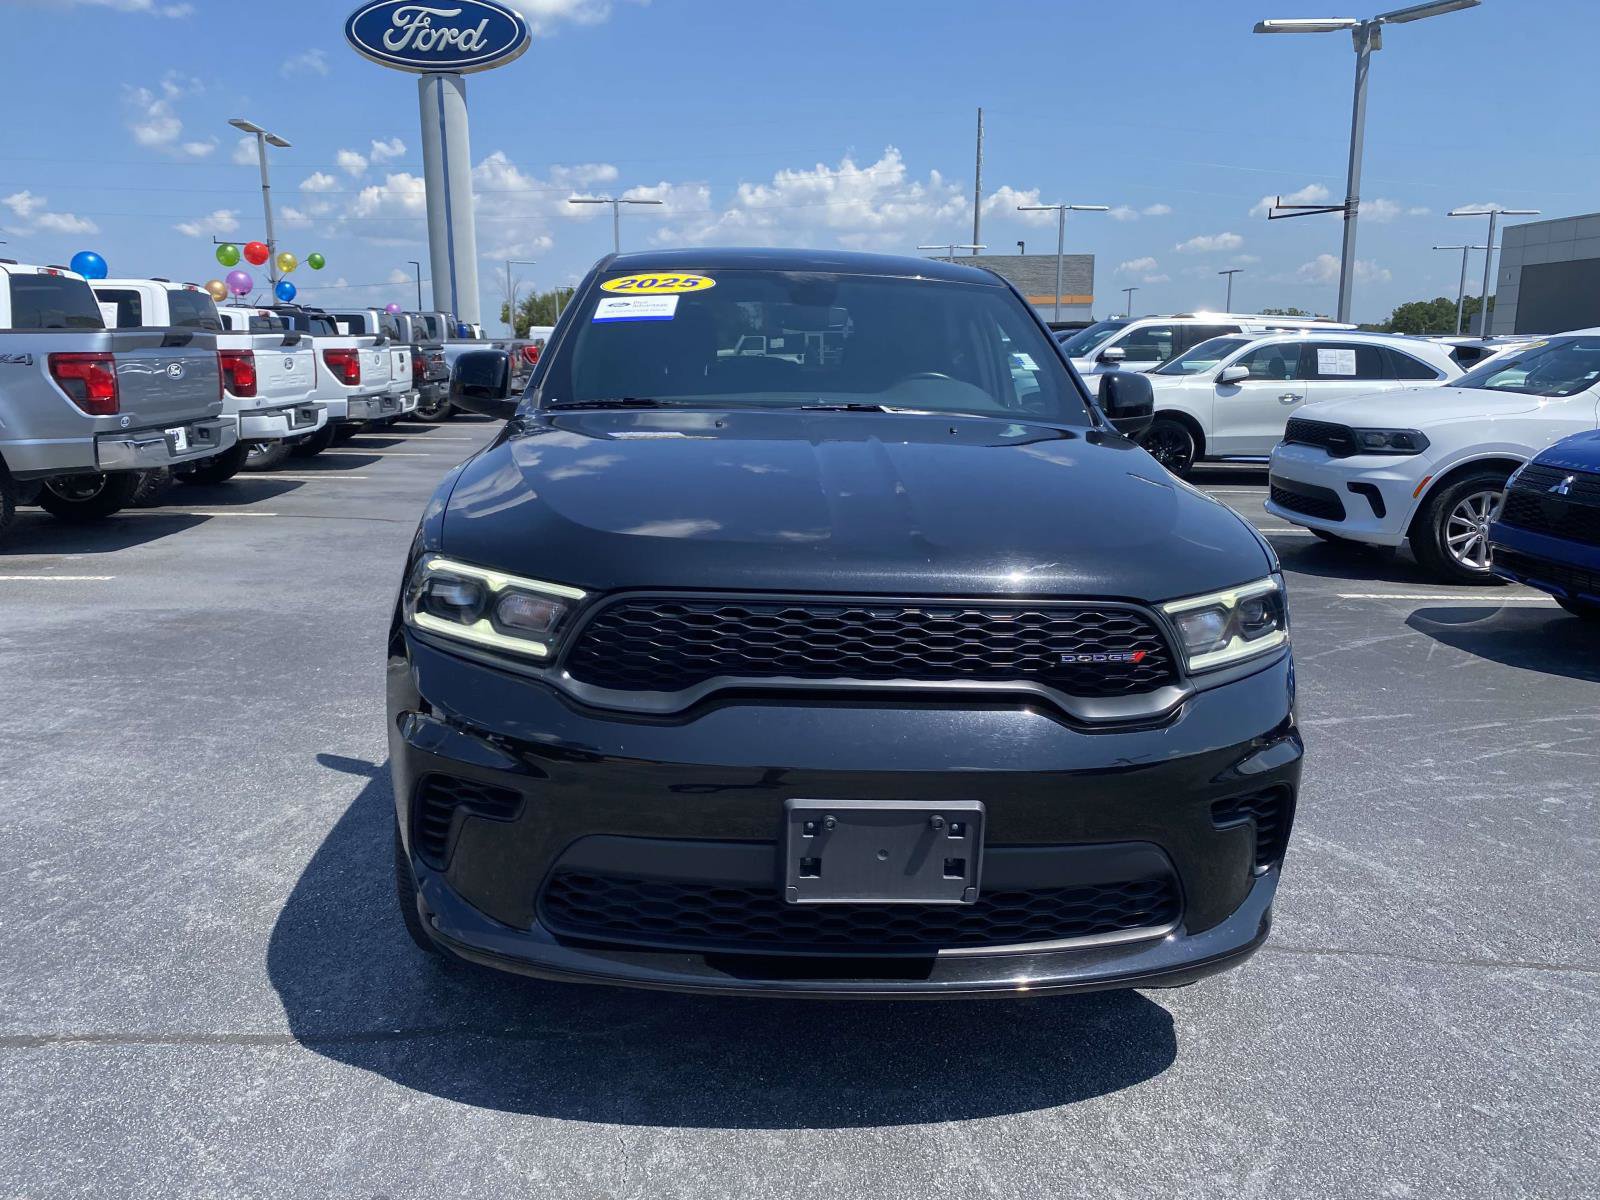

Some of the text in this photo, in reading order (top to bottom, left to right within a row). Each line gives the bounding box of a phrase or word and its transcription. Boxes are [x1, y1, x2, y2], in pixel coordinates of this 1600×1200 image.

[382, 5, 490, 52] Ford
[612, 277, 703, 290] 2025
[1061, 654, 1136, 663] DODGE
